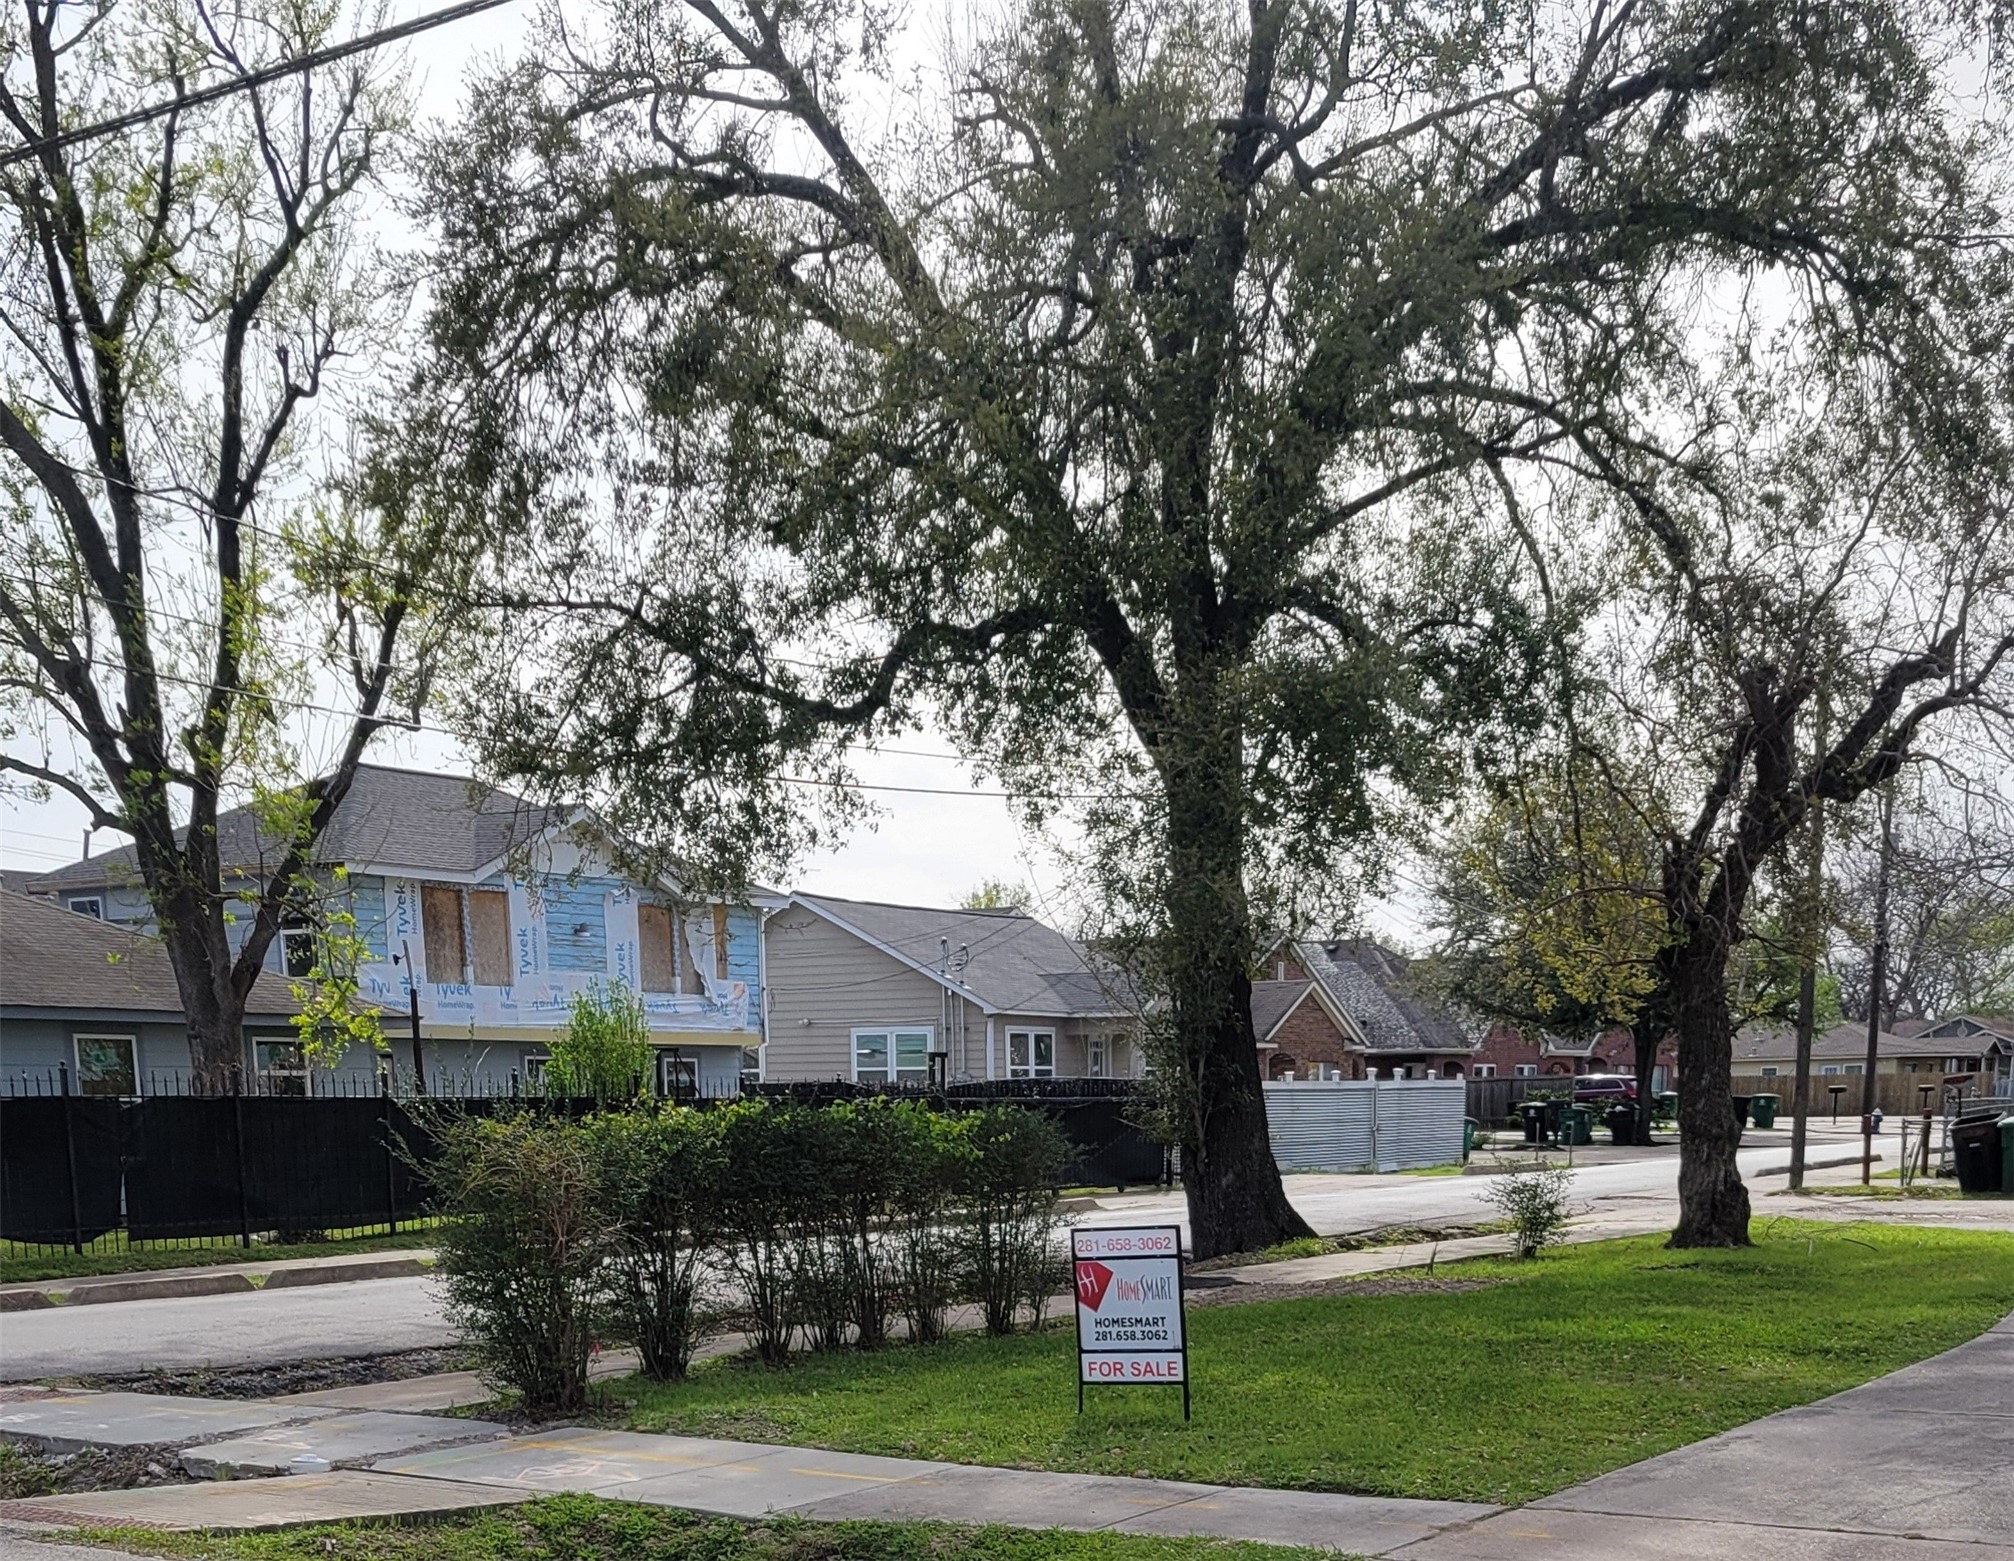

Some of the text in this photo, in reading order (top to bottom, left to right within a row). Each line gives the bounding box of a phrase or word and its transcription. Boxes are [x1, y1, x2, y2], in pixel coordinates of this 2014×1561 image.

[394, 882, 411, 937] Tyvek
[517, 927, 532, 977] Tyvek
[615, 942, 629, 984] yvek
[436, 983, 472, 999] Tyvek
[1077, 1237, 1172, 1253] 281-658-3062
[1094, 1317, 1166, 1328] HOMESMART
[1094, 1330, 1168, 1341] 281.658.3062
[1088, 1361, 1178, 1377] FOR SALE
